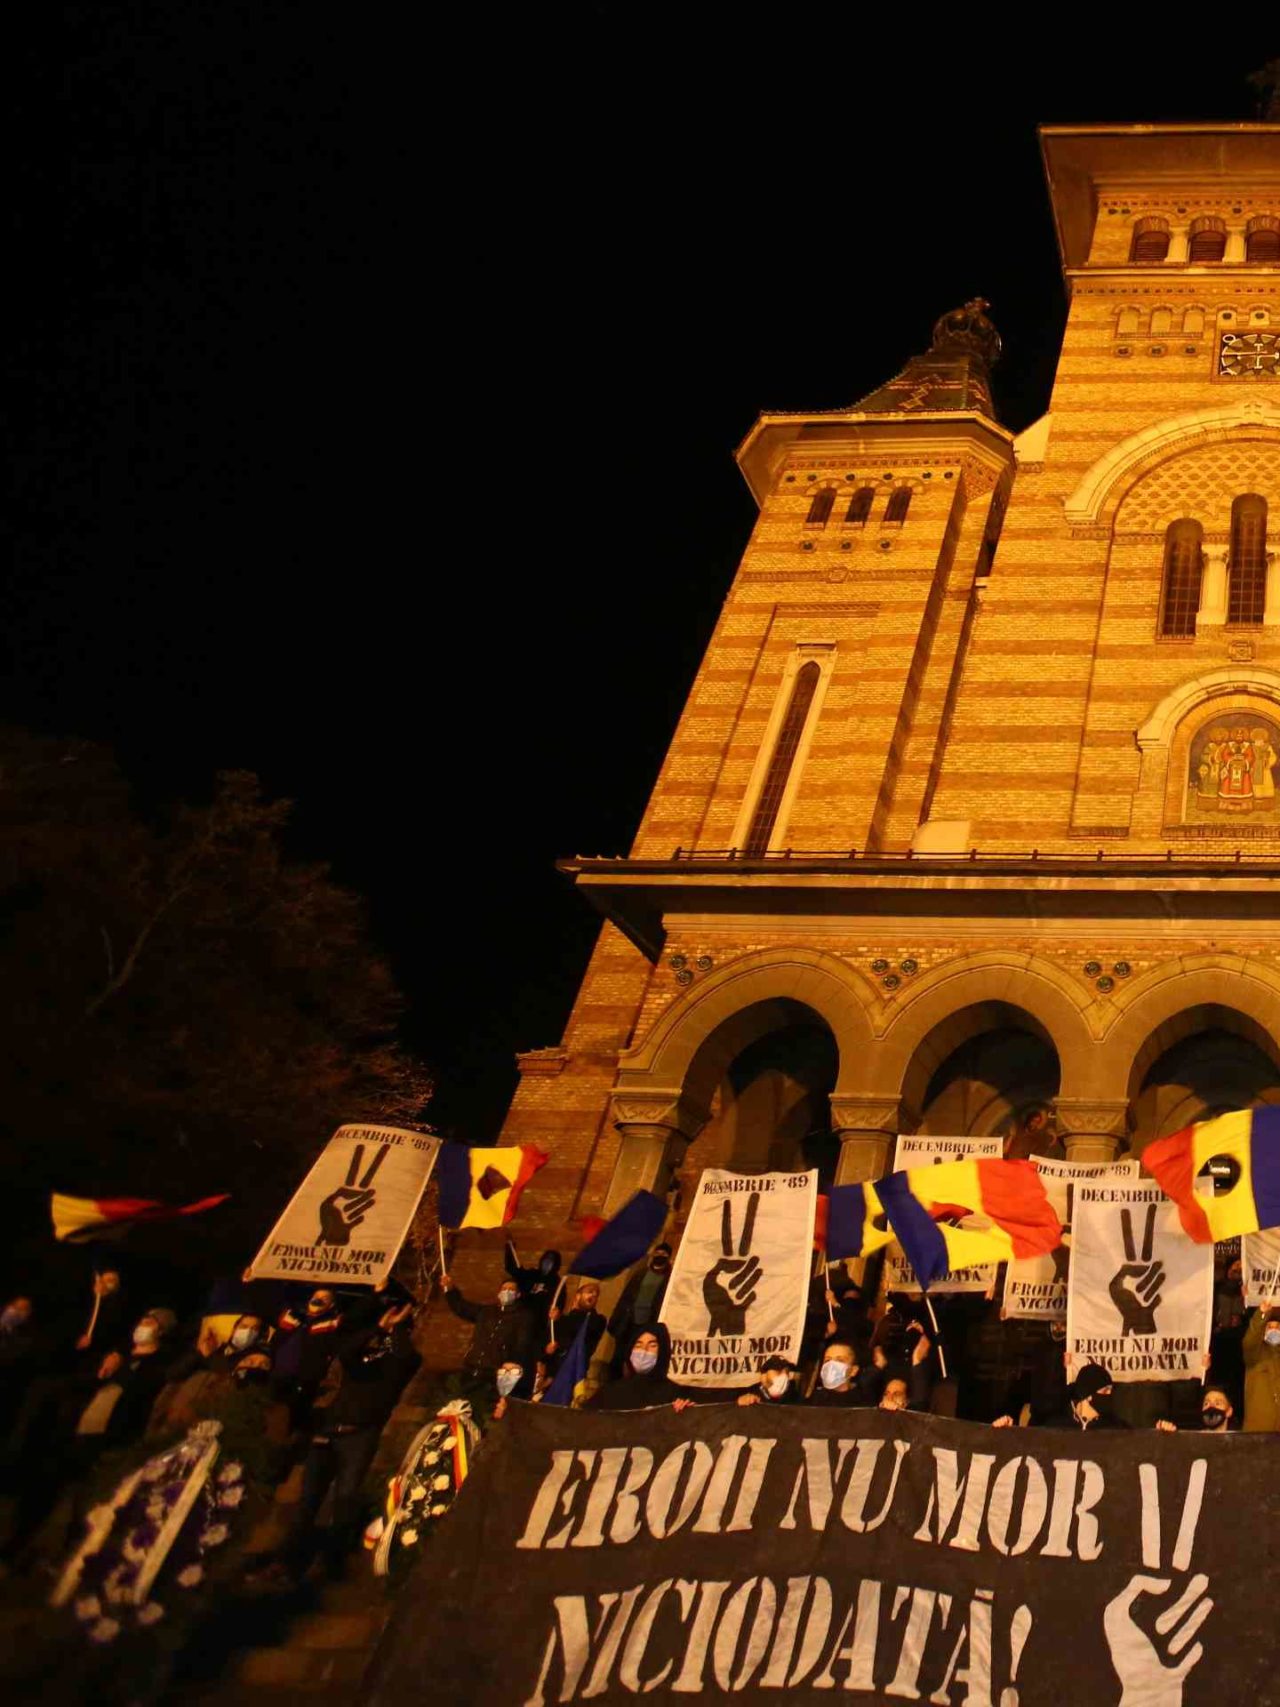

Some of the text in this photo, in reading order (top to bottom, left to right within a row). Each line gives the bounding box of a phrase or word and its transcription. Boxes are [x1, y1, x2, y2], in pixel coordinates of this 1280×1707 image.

[903, 1141, 974, 1153] DECEMBRIE
[782, 1175, 809, 1188] '89
[671, 1336, 792, 1355] ROII NU MOR
[1075, 1337, 1199, 1354] EROII NU MOR
[515, 1435, 1105, 1561] EROII NU MOR
